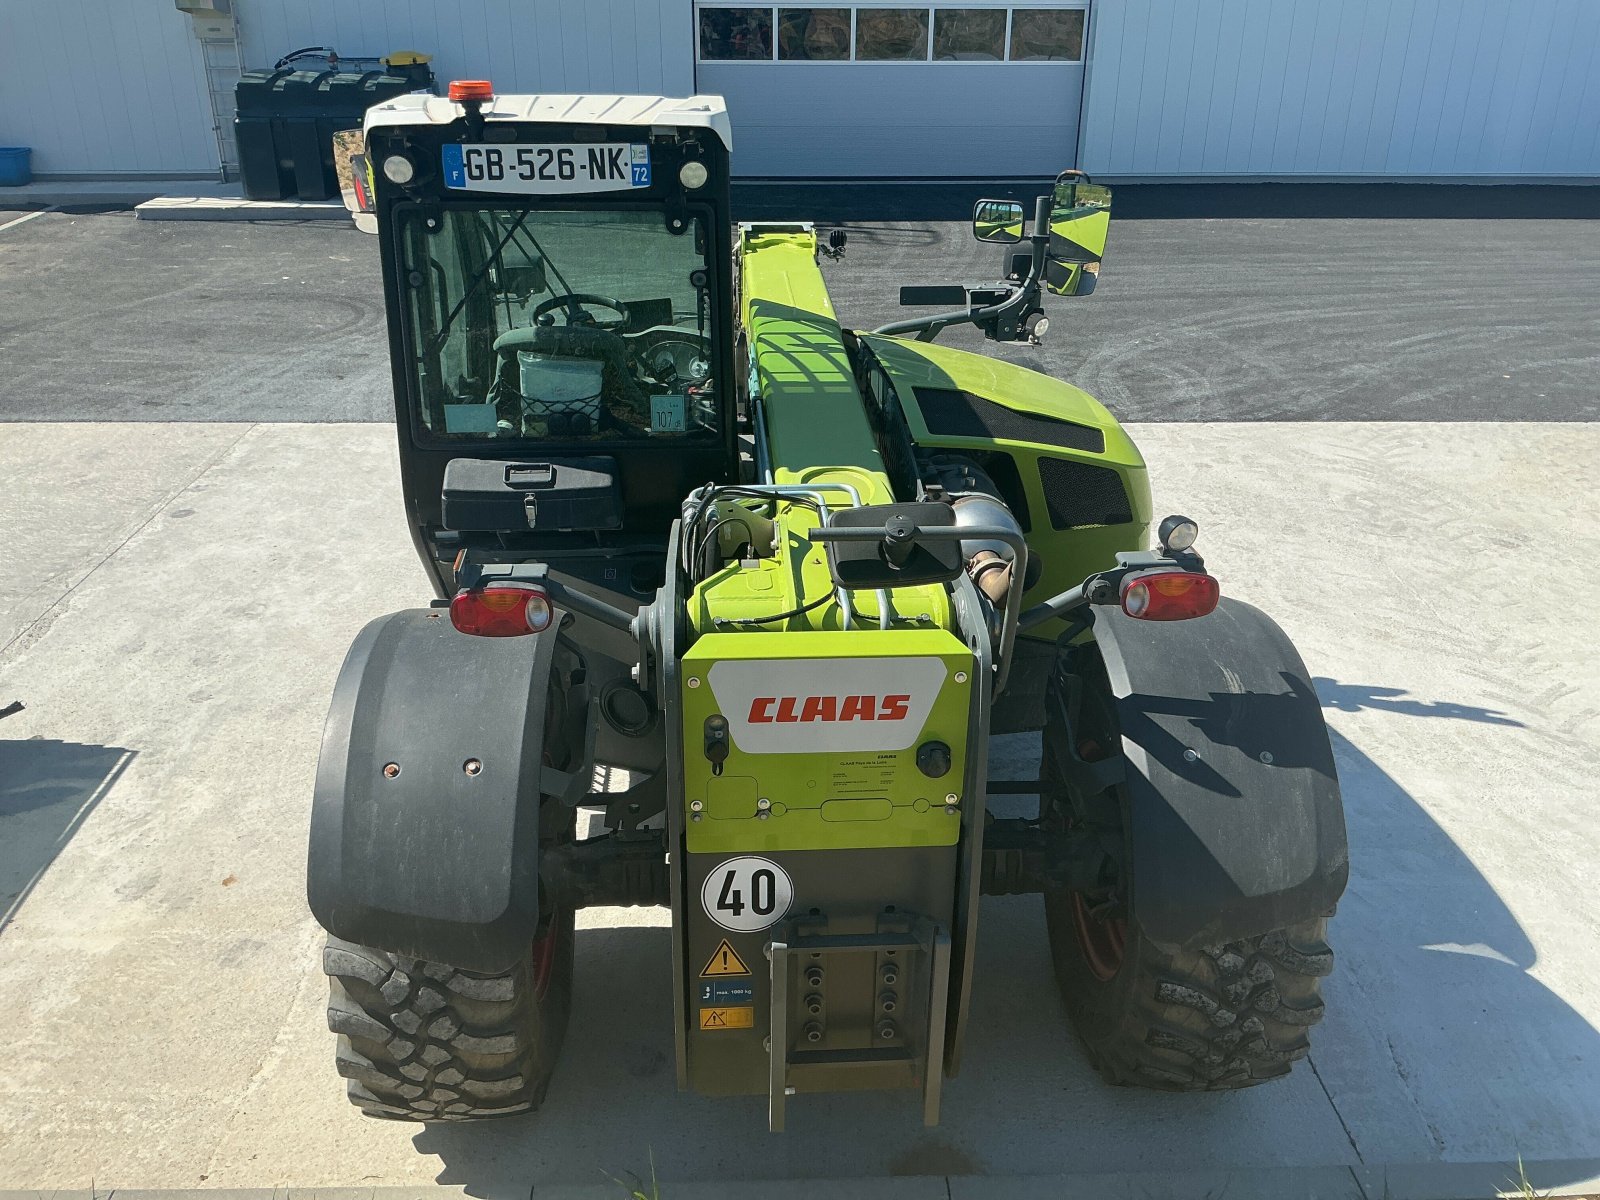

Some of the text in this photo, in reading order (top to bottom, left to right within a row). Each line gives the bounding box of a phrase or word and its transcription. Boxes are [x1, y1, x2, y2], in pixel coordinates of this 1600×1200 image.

[465, 148, 626, 181] GB-526-NK
[633, 167, 648, 182] 72
[656, 412, 672, 428] 107
[748, 695, 910, 724] CLAAS
[716, 868, 776, 917] 40
